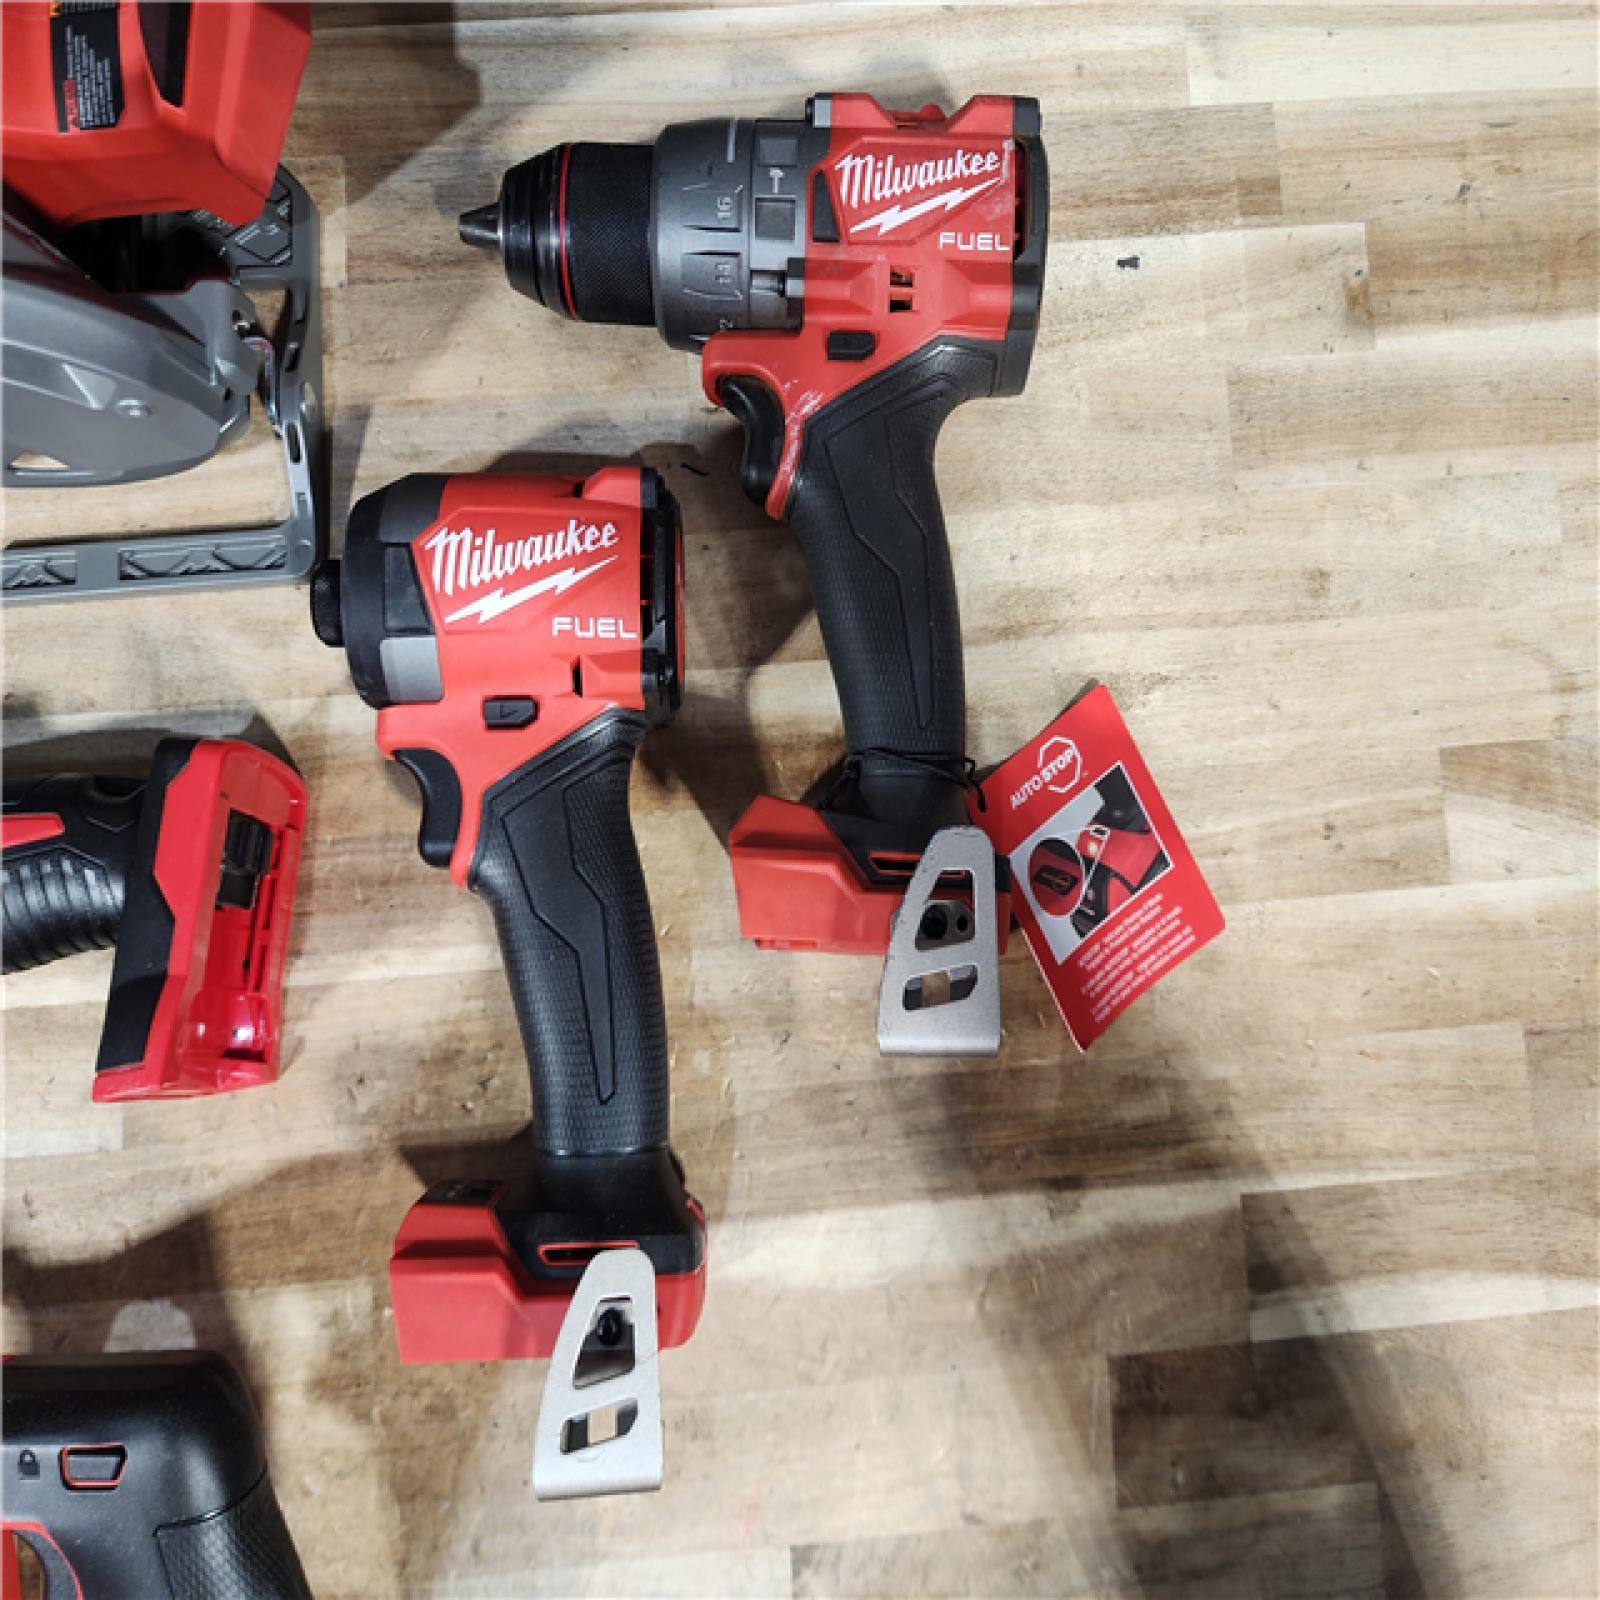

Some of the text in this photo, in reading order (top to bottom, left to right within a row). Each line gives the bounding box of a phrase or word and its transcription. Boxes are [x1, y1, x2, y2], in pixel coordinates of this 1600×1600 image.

[835, 149, 999, 208] Milwaukee
[938, 231, 1011, 251] FUEL
[424, 519, 619, 596] Milwaukee
[552, 616, 639, 639] FUEL
[1010, 746, 1076, 810] AUTO STOP
